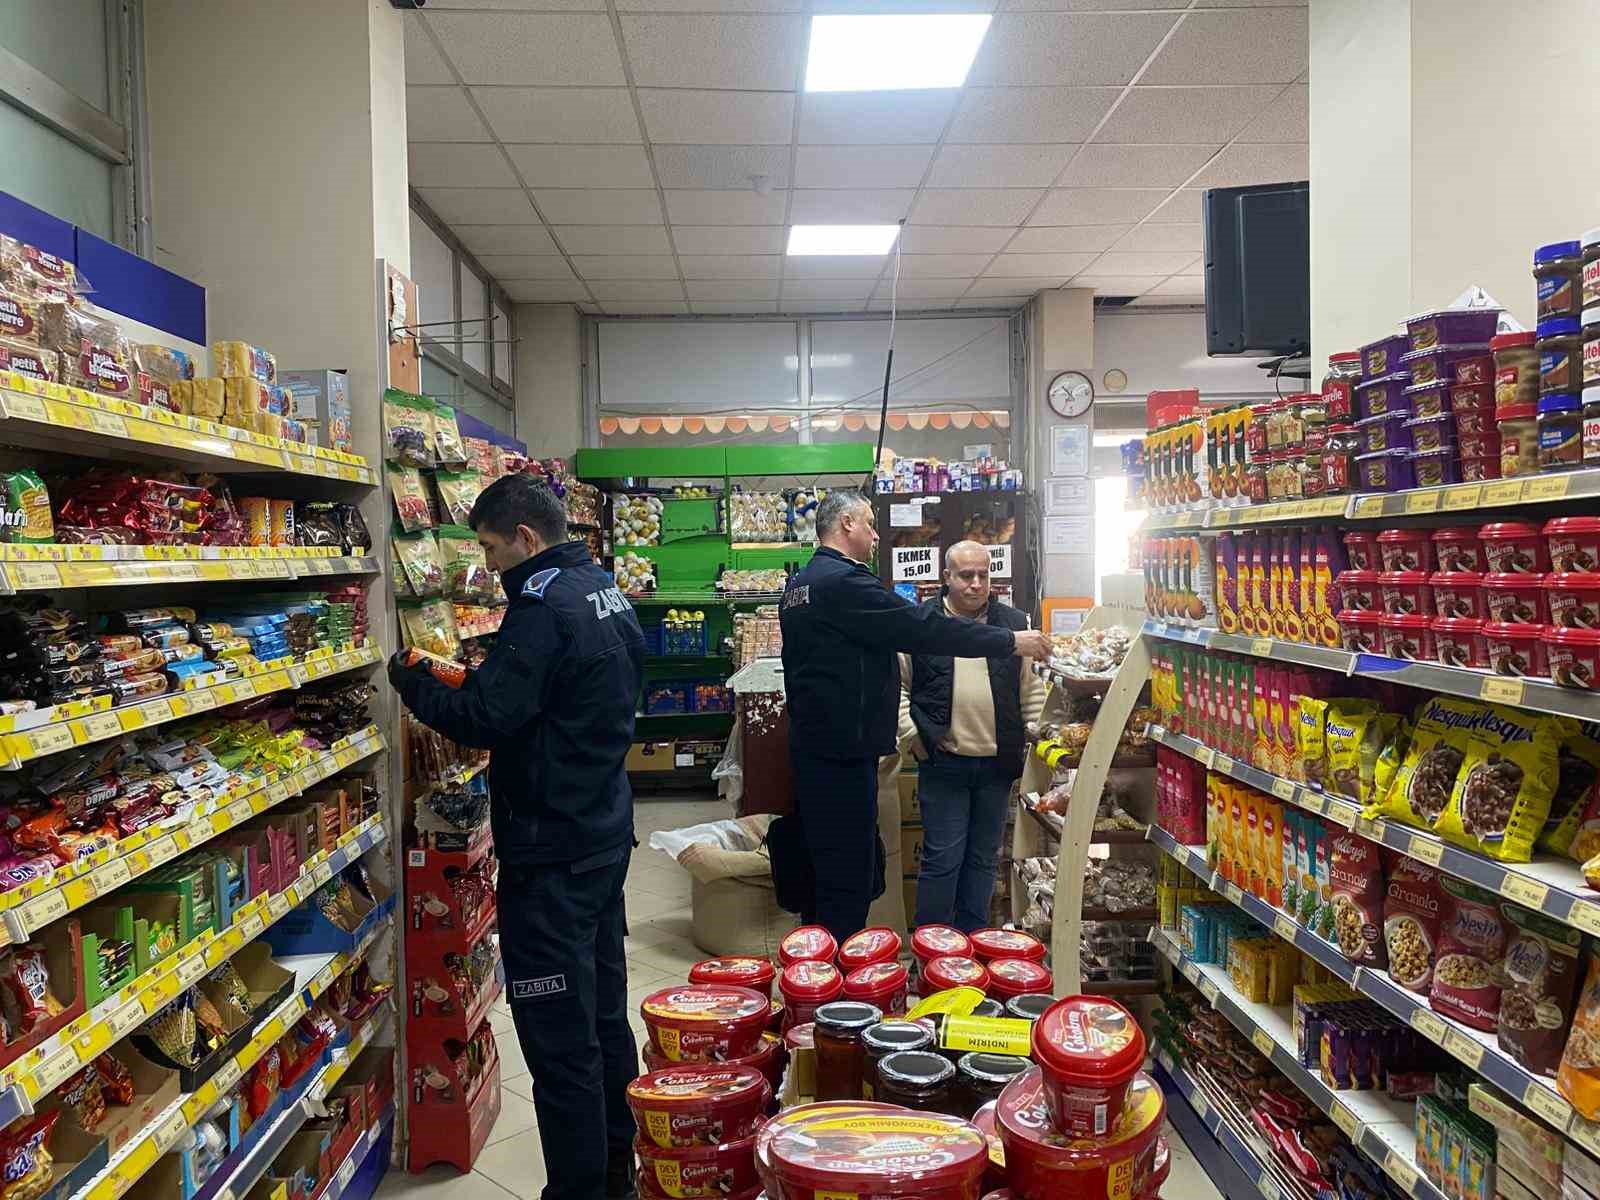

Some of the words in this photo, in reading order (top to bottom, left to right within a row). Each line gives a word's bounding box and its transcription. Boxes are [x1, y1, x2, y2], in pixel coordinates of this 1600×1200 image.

[12, 357, 38, 371] petit
[898, 550, 931, 563] EKMEK
[904, 563, 931, 577] 15.00
[1426, 702, 1480, 729] Nesquik
[1331, 864, 1367, 889] Granola
[1388, 883, 1438, 911] Granola
[518, 980, 559, 994] ZABITA
[662, 1031, 676, 1040] DEV
[650, 1115, 666, 1124] DEV
